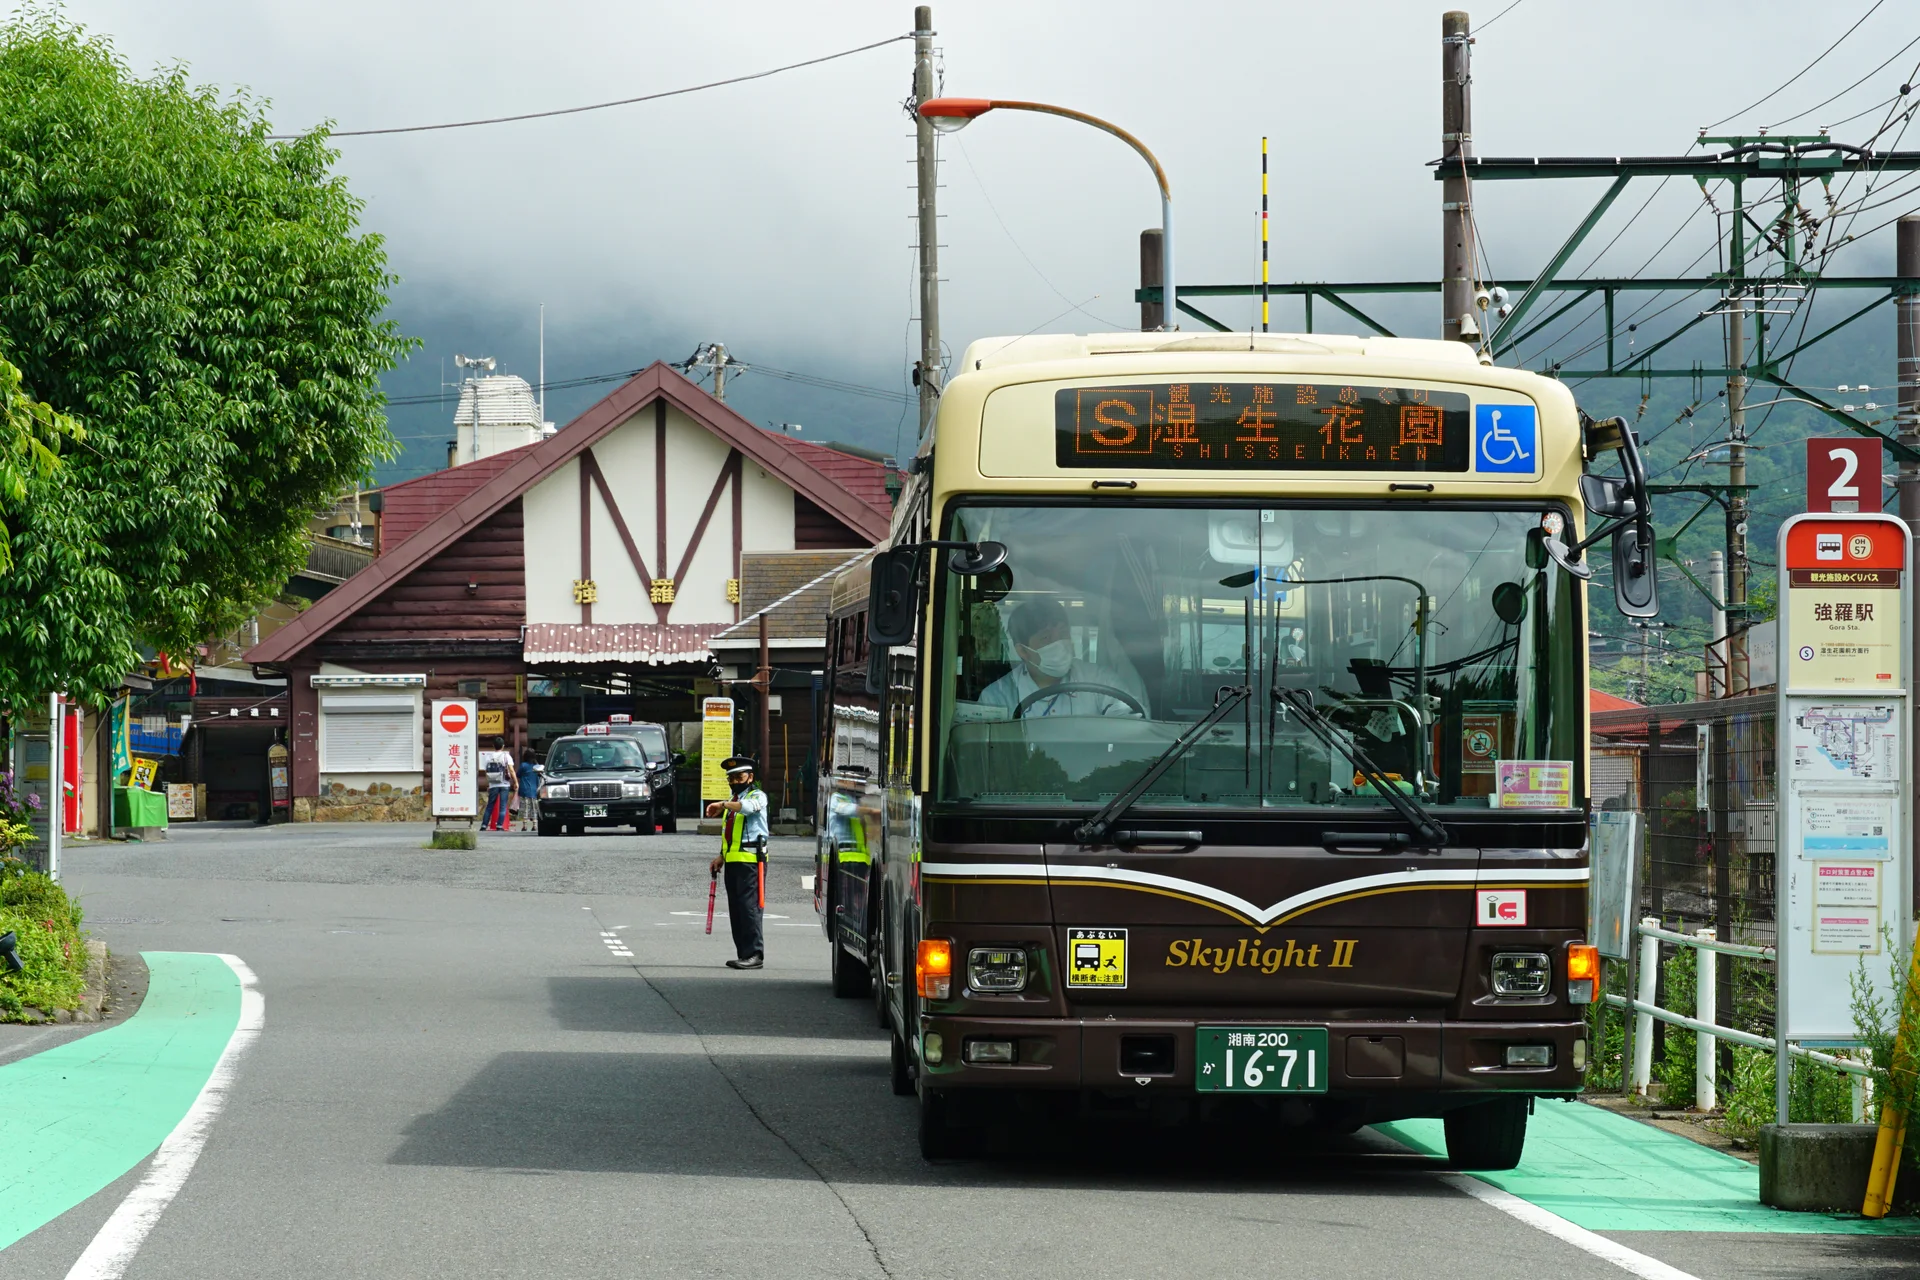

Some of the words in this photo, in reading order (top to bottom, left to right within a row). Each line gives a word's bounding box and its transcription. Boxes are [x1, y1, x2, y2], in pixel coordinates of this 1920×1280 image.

[1168, 384, 1429, 405] 観光施設めぐり
[1091, 399, 1138, 446] S
[1828, 448, 1859, 497] 2
[1854, 546, 1866, 555] 57
[1810, 573, 1879, 582] 観光施設めぐりバス
[1814, 602, 1874, 622] 強羅駅
[1804, 649, 1809, 658] S
[478, 714, 501, 724] リッツ
[448, 743, 461, 795] 進入禁止
[1076, 931, 1117, 939] あぶない
[1166, 938, 1322, 974] Skylight
[1072, 974, 1123, 983] 横断者に注意!
[1202, 1062, 1216, 1075] か
[1225, 1049, 1316, 1088] 16-71
